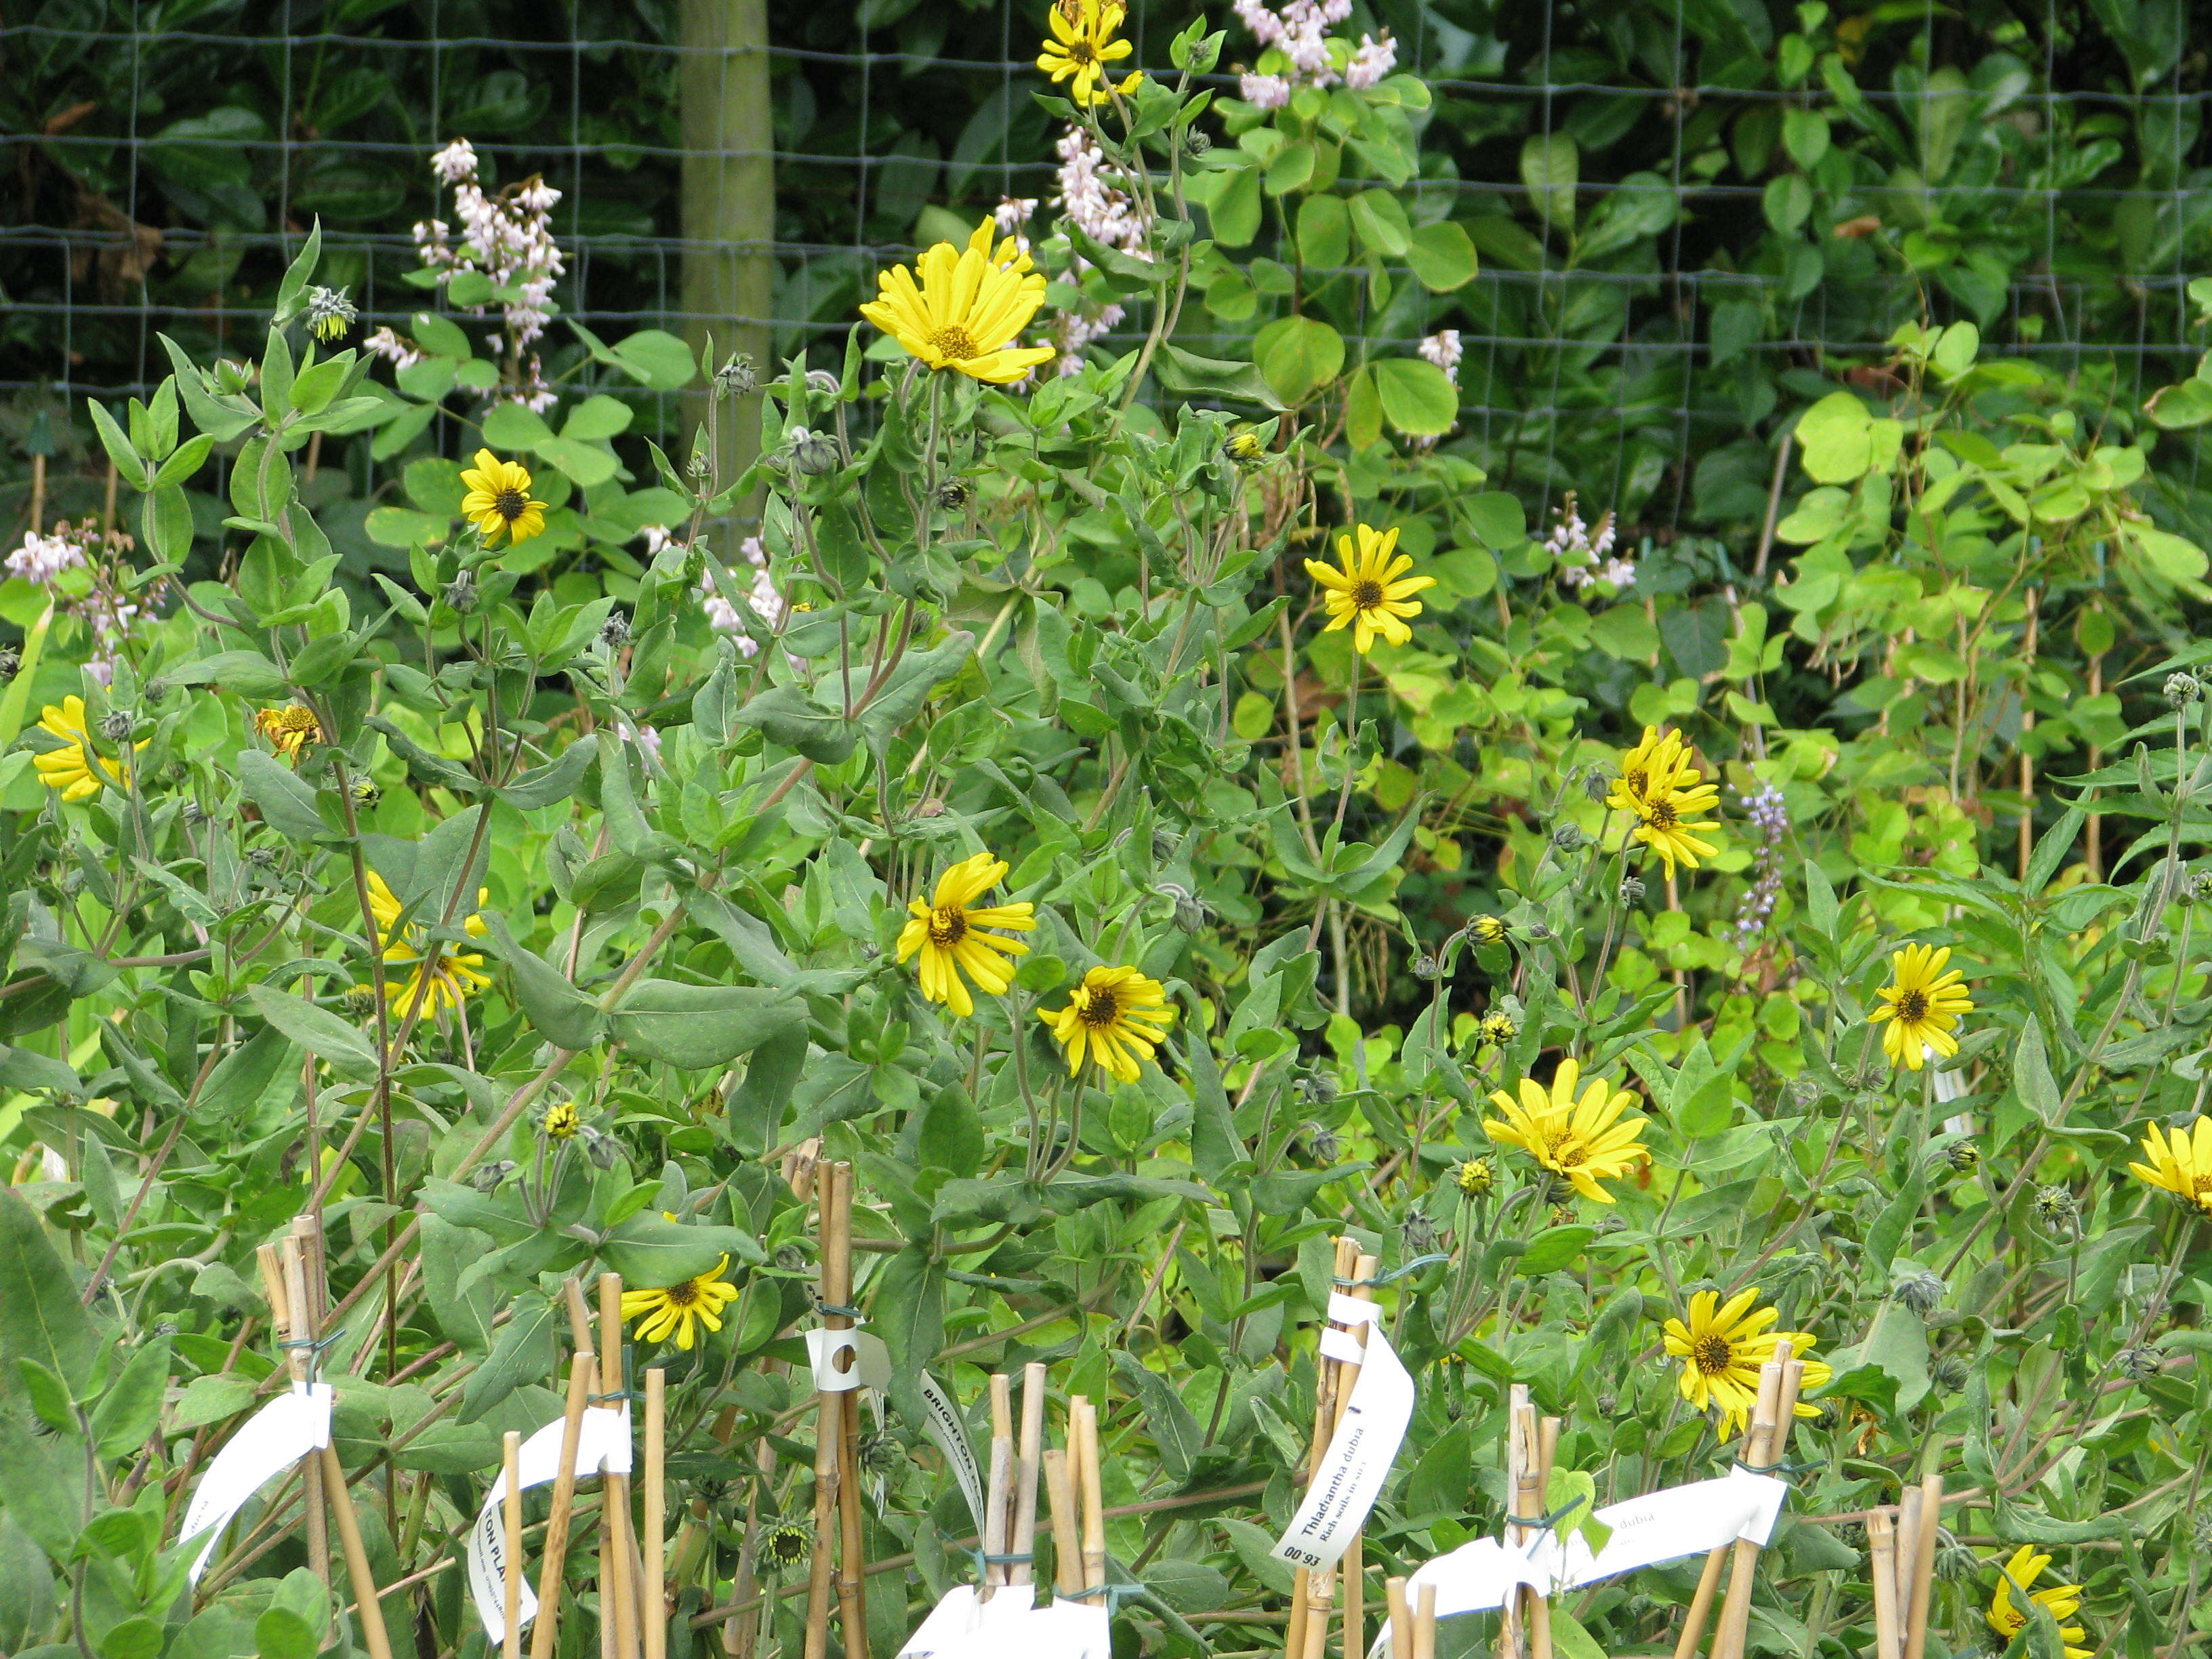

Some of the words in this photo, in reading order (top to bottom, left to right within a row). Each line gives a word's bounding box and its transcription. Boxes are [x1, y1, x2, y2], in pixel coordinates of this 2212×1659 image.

[923, 1388, 972, 1470] BRIGHTON
[1301, 1465, 1348, 1536] Thladiantha
[1343, 1427, 1364, 1462] dubia
[1319, 1519, 1338, 1542] Rich
[1336, 1494, 1351, 1519] soils
[490, 1544, 506, 1583] PLA
